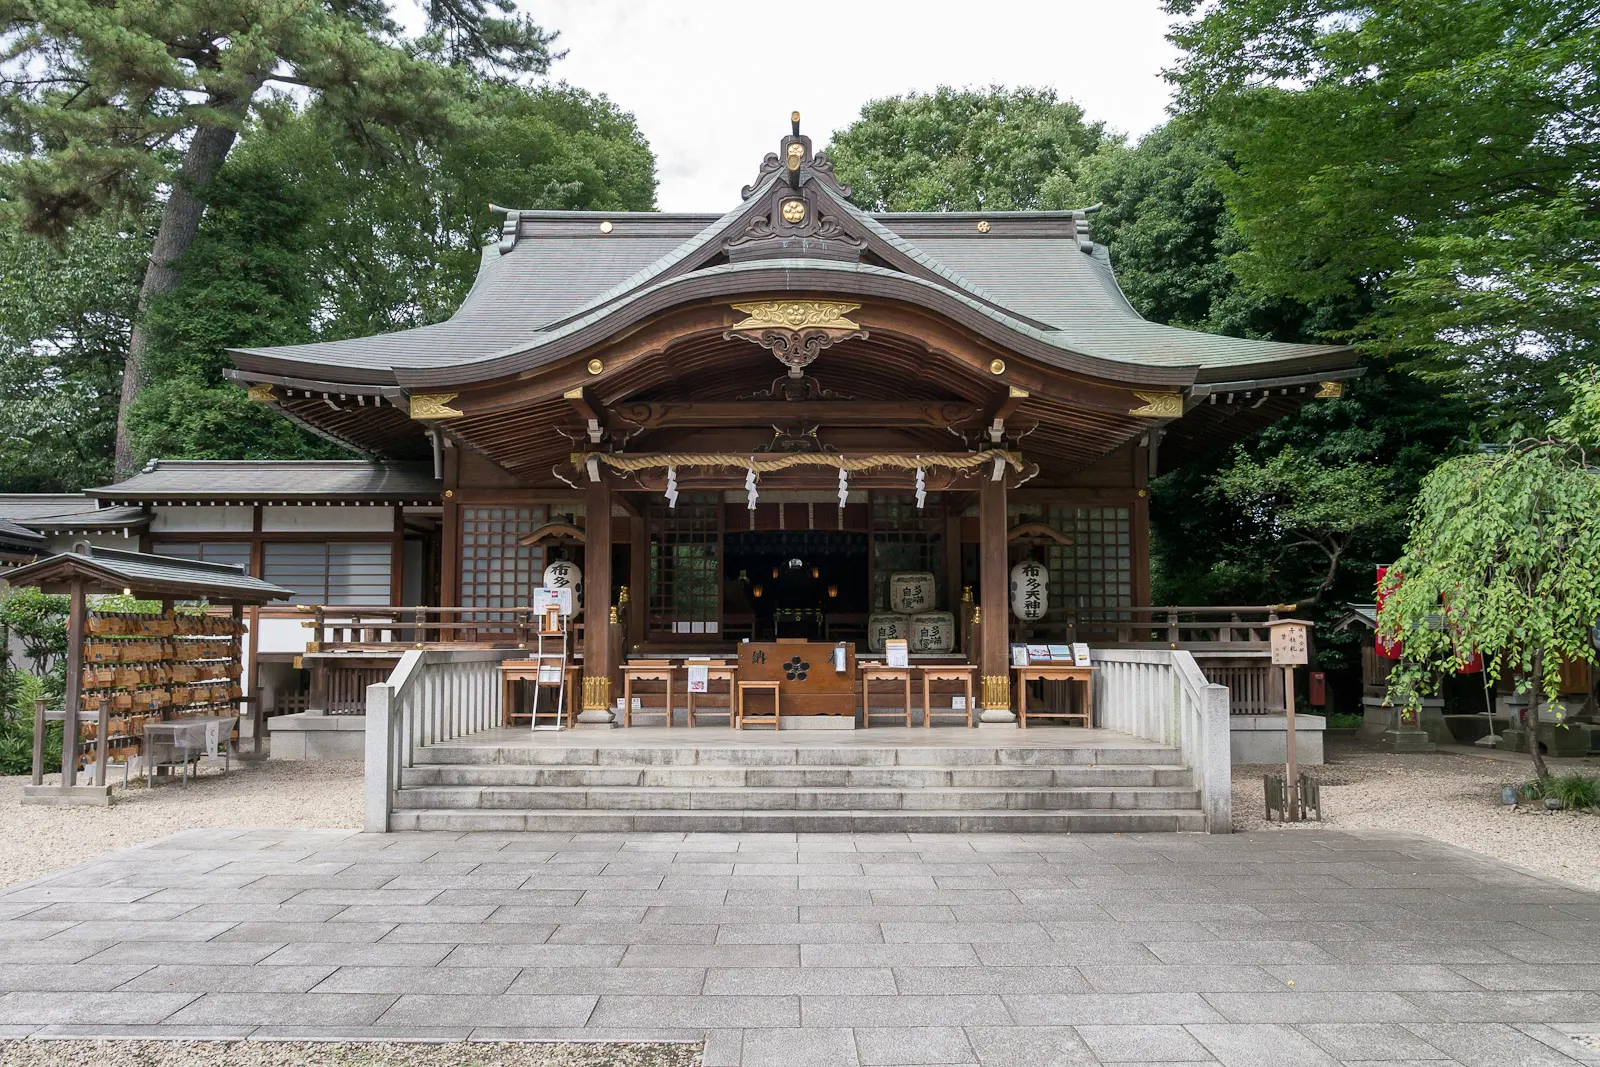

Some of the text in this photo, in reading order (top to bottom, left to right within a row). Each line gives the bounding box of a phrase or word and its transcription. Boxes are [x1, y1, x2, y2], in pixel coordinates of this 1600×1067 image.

[1021, 563, 1041, 618] 布多天神社
